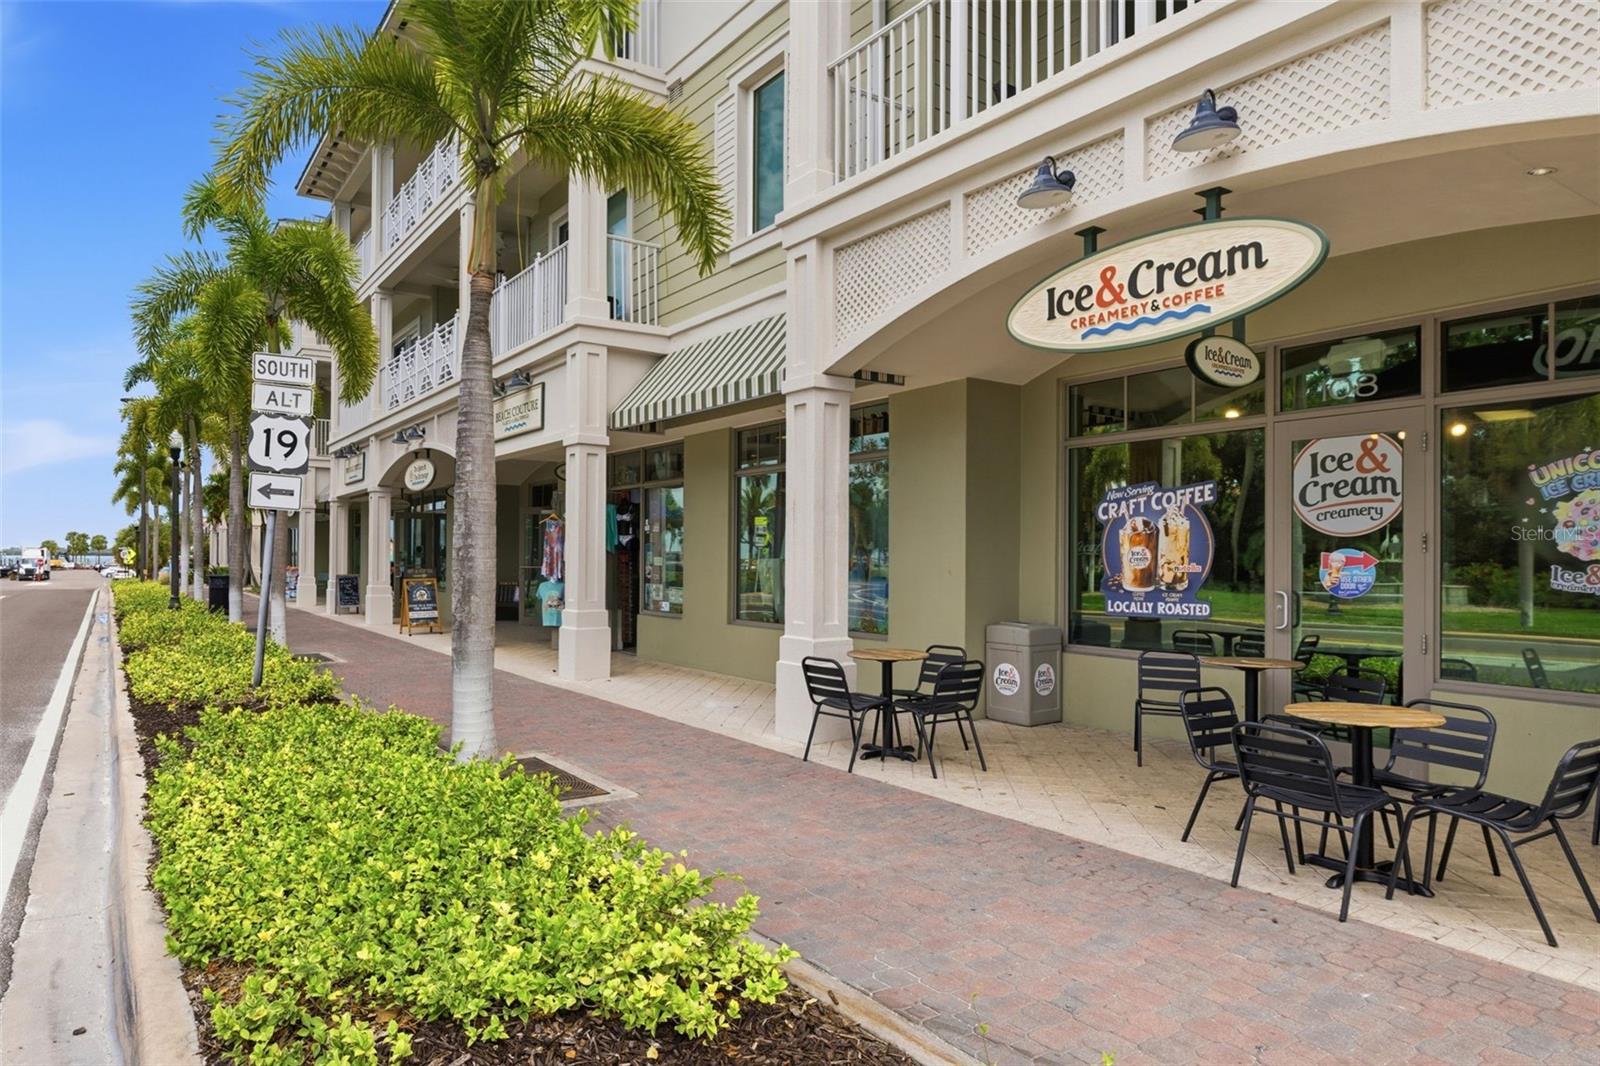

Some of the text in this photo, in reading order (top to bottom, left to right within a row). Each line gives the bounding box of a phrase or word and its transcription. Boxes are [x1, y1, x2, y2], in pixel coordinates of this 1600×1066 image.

[257, 359, 309, 379] SOUTH
[1322, 373, 1378, 401] 108
[266, 390, 302, 408] ALT
[263, 427, 298, 458] 19
[1106, 485, 1155, 501] Now Serving
[1298, 475, 1401, 508] Cream
[1541, 480, 1568, 500] ICE
[1097, 483, 1214, 520] CRAFT COFFEE
[1316, 506, 1383, 522] creamery
[1108, 600, 1210, 616] LOCALLY ROASTED
[996, 677, 1018, 687] Cream
